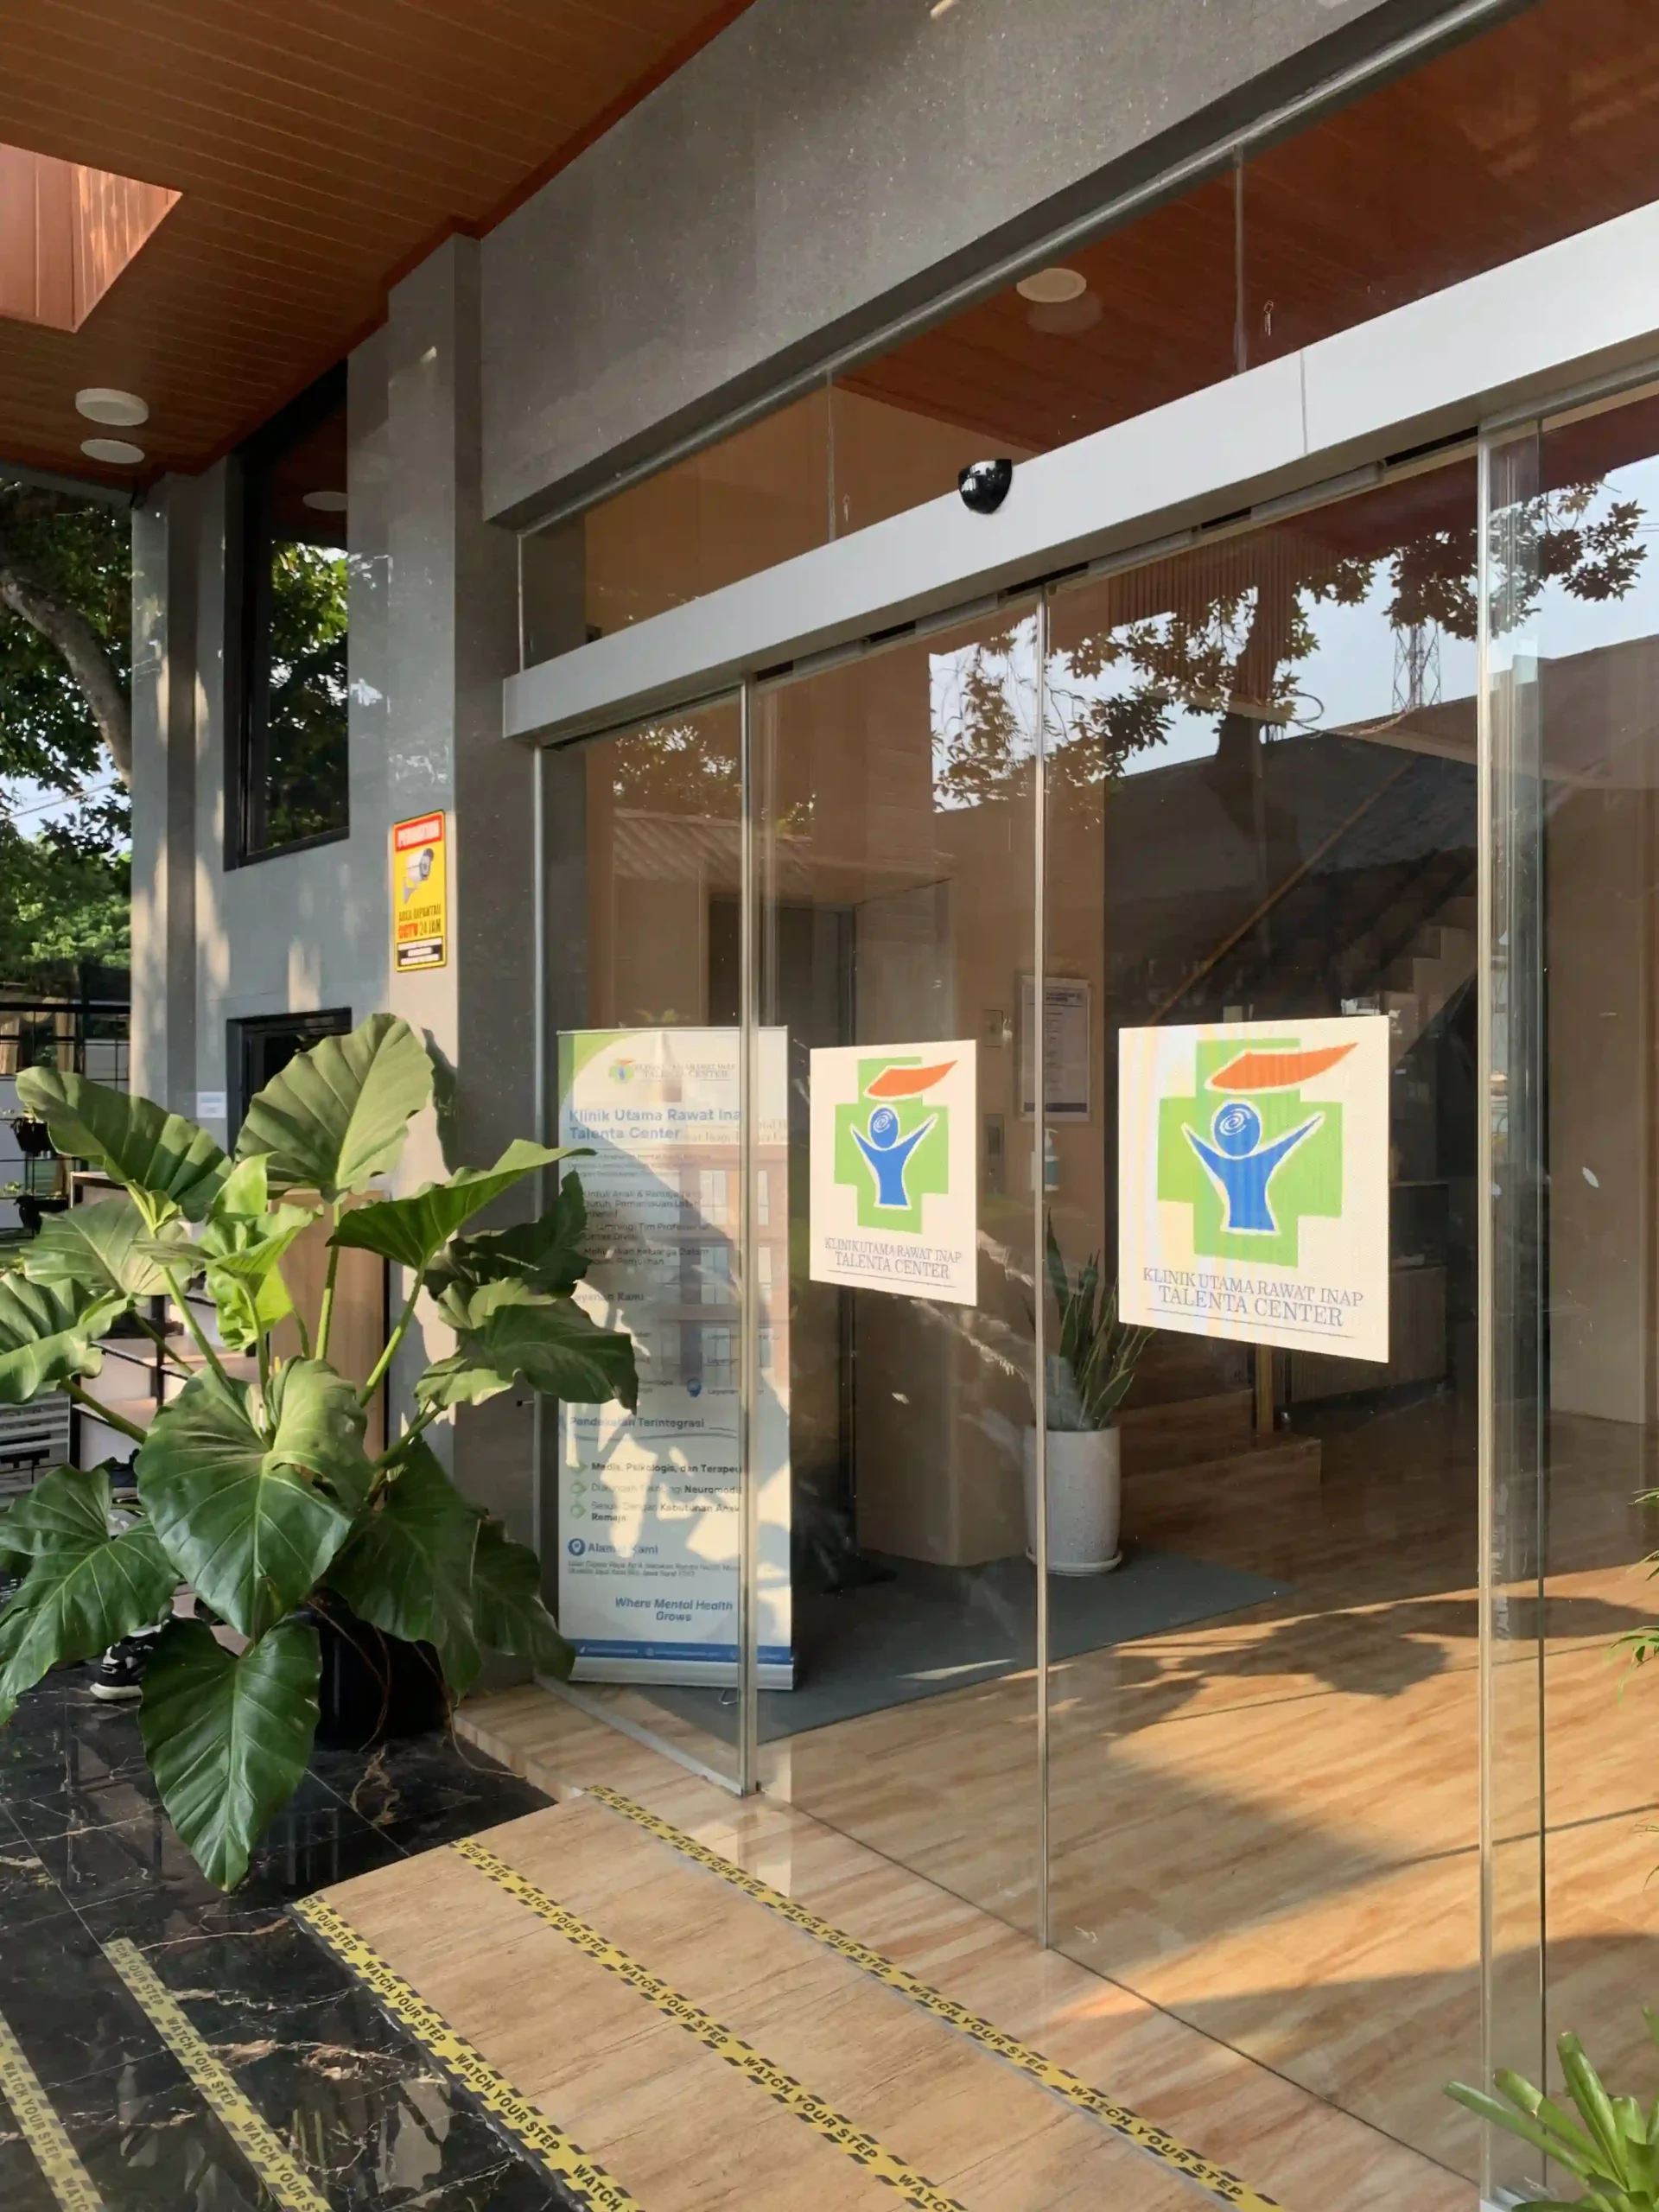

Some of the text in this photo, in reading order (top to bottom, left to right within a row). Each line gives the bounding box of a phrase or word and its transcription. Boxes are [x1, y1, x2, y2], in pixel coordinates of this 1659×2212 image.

[419, 922, 428, 936] 24
[429, 918, 442, 934] JAM
[569, 1109, 741, 1122] Klinik Utama Rawat Ina
[569, 1127, 626, 1140] Talenta
[629, 1127, 680, 1140] Center
[825, 1237, 962, 1263] KLINIK UTAMA RAWAT INAP
[835, 1251, 950, 1280] TALENTA CENTER
[1143, 1267, 1363, 1307] KLINIK UTAMA RAWAT INAP
[1159, 1285, 1344, 1327] TALENTA CENTER
[638, 1417, 705, 1430] Terintegrasi
[702, 1464, 742, 1476] Terapeu
[615, 1597, 734, 1611] Where Mental Health
[656, 1611, 692, 1622] Grows
[461, 1841, 954, 2212] YOUR STEP WATCH YOUR STEP WATCH YOUR STEP WATCH YOUR STEP WATC
[668, 1834, 705, 1858] WATCH
[705, 1856, 737, 1878] YOUR
[735, 1876, 766, 1894] STEP
[779, 1902, 821, 1930] WATCH
[821, 1928, 857, 1954] YOUR
[856, 1951, 893, 1975] STEP
[908, 1984, 961, 2018] WATCH
[961, 2015, 1007, 2047] YOUR
[1005, 2044, 1049, 2074] STEP
[1071, 2084, 1133, 2126] WATCH
[1135, 2124, 1191, 2164] YOUR
[1189, 2161, 1244, 2196] STEP
[314, 1910, 623, 2212] YOUR STEP WATCH YOUR STEP WATCH YOUR STEP WATCH
[125, 1961, 148, 1989] YOUR
[142, 1983, 165, 2006] STEP
[166, 2017, 194, 2052] WATCH
[188, 2050, 216, 2082] YOUR
[211, 2080, 238, 2108] STEP
[241, 2121, 280, 2167] WATCH
[275, 2164, 308, 2202] YOUR
[2, 2061, 90, 2212] WATCH YOUR STEP WATC
